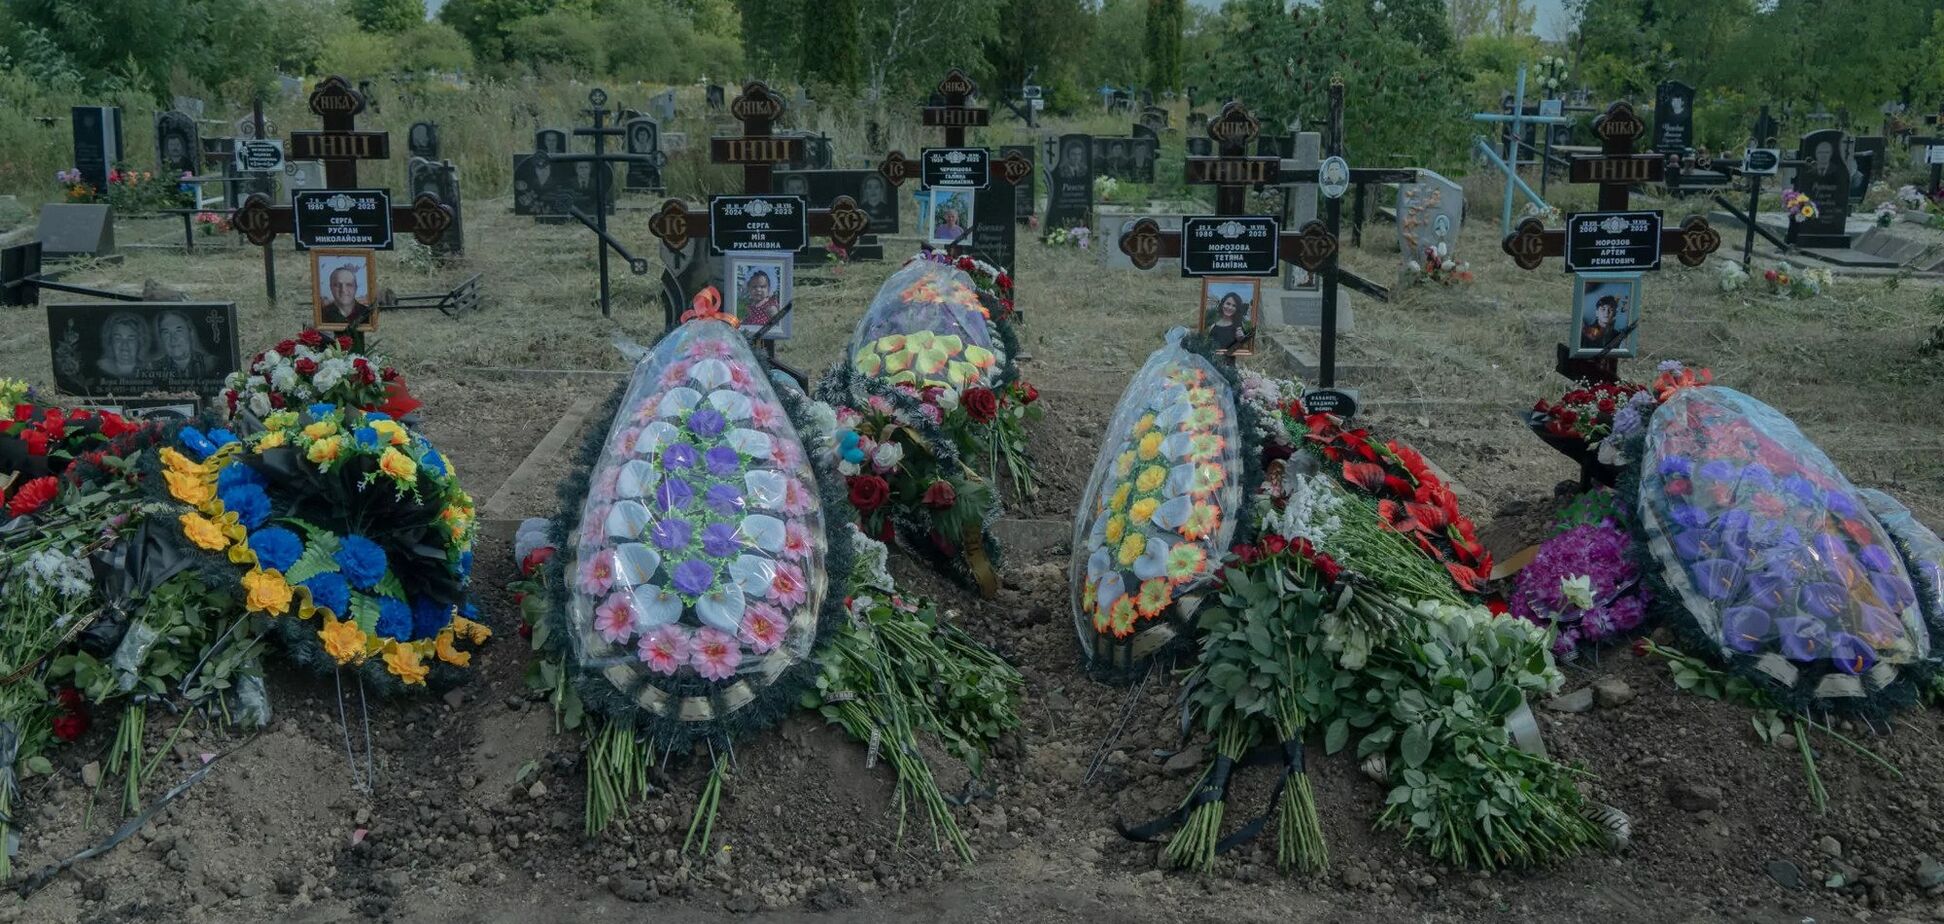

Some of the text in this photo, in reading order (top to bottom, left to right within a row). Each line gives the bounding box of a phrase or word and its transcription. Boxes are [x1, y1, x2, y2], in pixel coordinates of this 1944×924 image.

[320, 95, 350, 110] НІКА
[742, 101, 772, 115] НІКА
[1606, 121, 1635, 135] НІКА
[314, 234, 373, 243] МИКОЛАЙОВИЧ
[1212, 261, 1248, 269] ІВАНІВНА
[1591, 257, 1635, 265] РЕНАТОВИЧ
